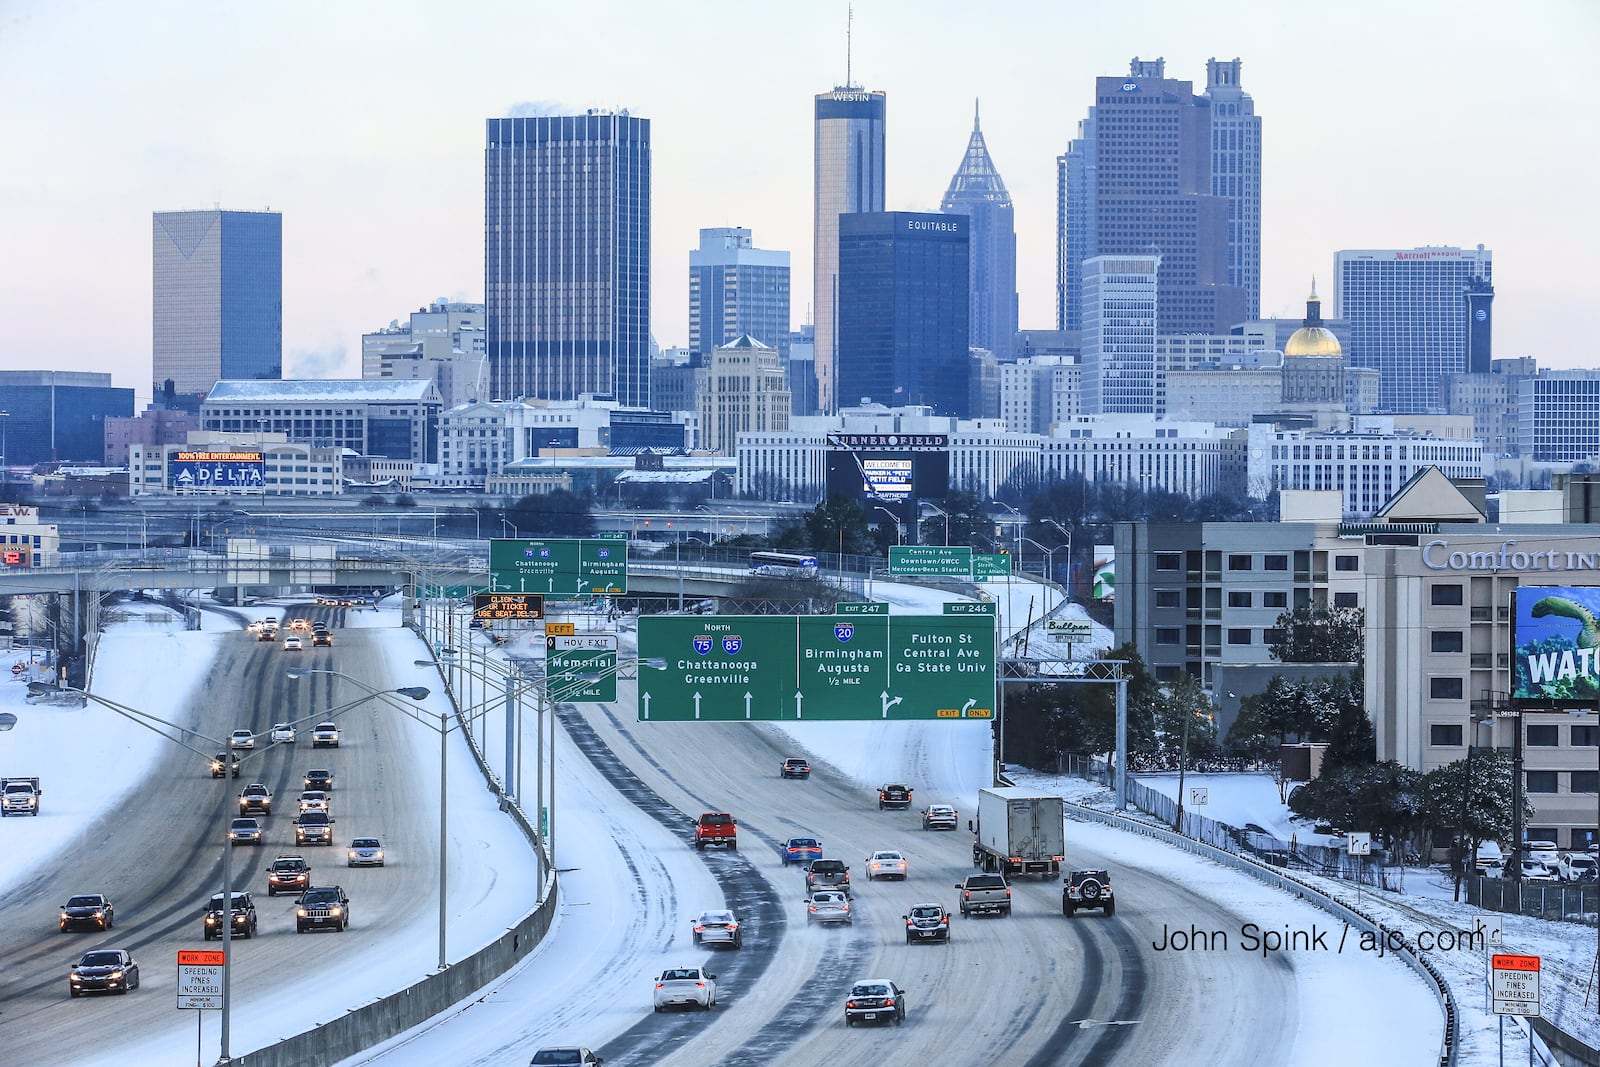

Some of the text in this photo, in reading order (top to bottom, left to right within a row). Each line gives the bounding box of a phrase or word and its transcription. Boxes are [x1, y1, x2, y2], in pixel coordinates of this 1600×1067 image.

[1123, 83, 1136, 91] GP
[833, 92, 869, 102] WESTIN
[908, 220, 957, 232] EQUITABLE
[838, 436, 943, 445] URNER FIELD
[200, 468, 262, 481] DELTA
[1422, 539, 1559, 571] Comfort
[515, 560, 559, 568] Chattanooga
[968, 605, 987, 613] 246
[548, 625, 571, 633] LEFT
[1048, 621, 1090, 632] Bullpen
[838, 628, 852, 638] 20
[588, 639, 608, 647] EXIT
[911, 633, 972, 644] Fulton St
[697, 640, 739, 651] 75 85
[805, 649, 883, 661] Birmingham
[903, 649, 980, 658] Central Ave
[552, 658, 611, 667] Memorial
[677, 660, 757, 671] Chattanooga
[817, 663, 870, 674] Augusta
[896, 662, 986, 673] Ga State Univ
[685, 674, 750, 684] Greenville
[182, 954, 221, 962] WORK ZONE
[1520, 960, 1536, 968] ZONE
[190, 976, 211, 984] FINES
[1499, 972, 1533, 980] SPEEDING
[181, 985, 219, 993] INCREASED
[1506, 982, 1526, 990] FINES
[1497, 990, 1535, 999] INCREASED
